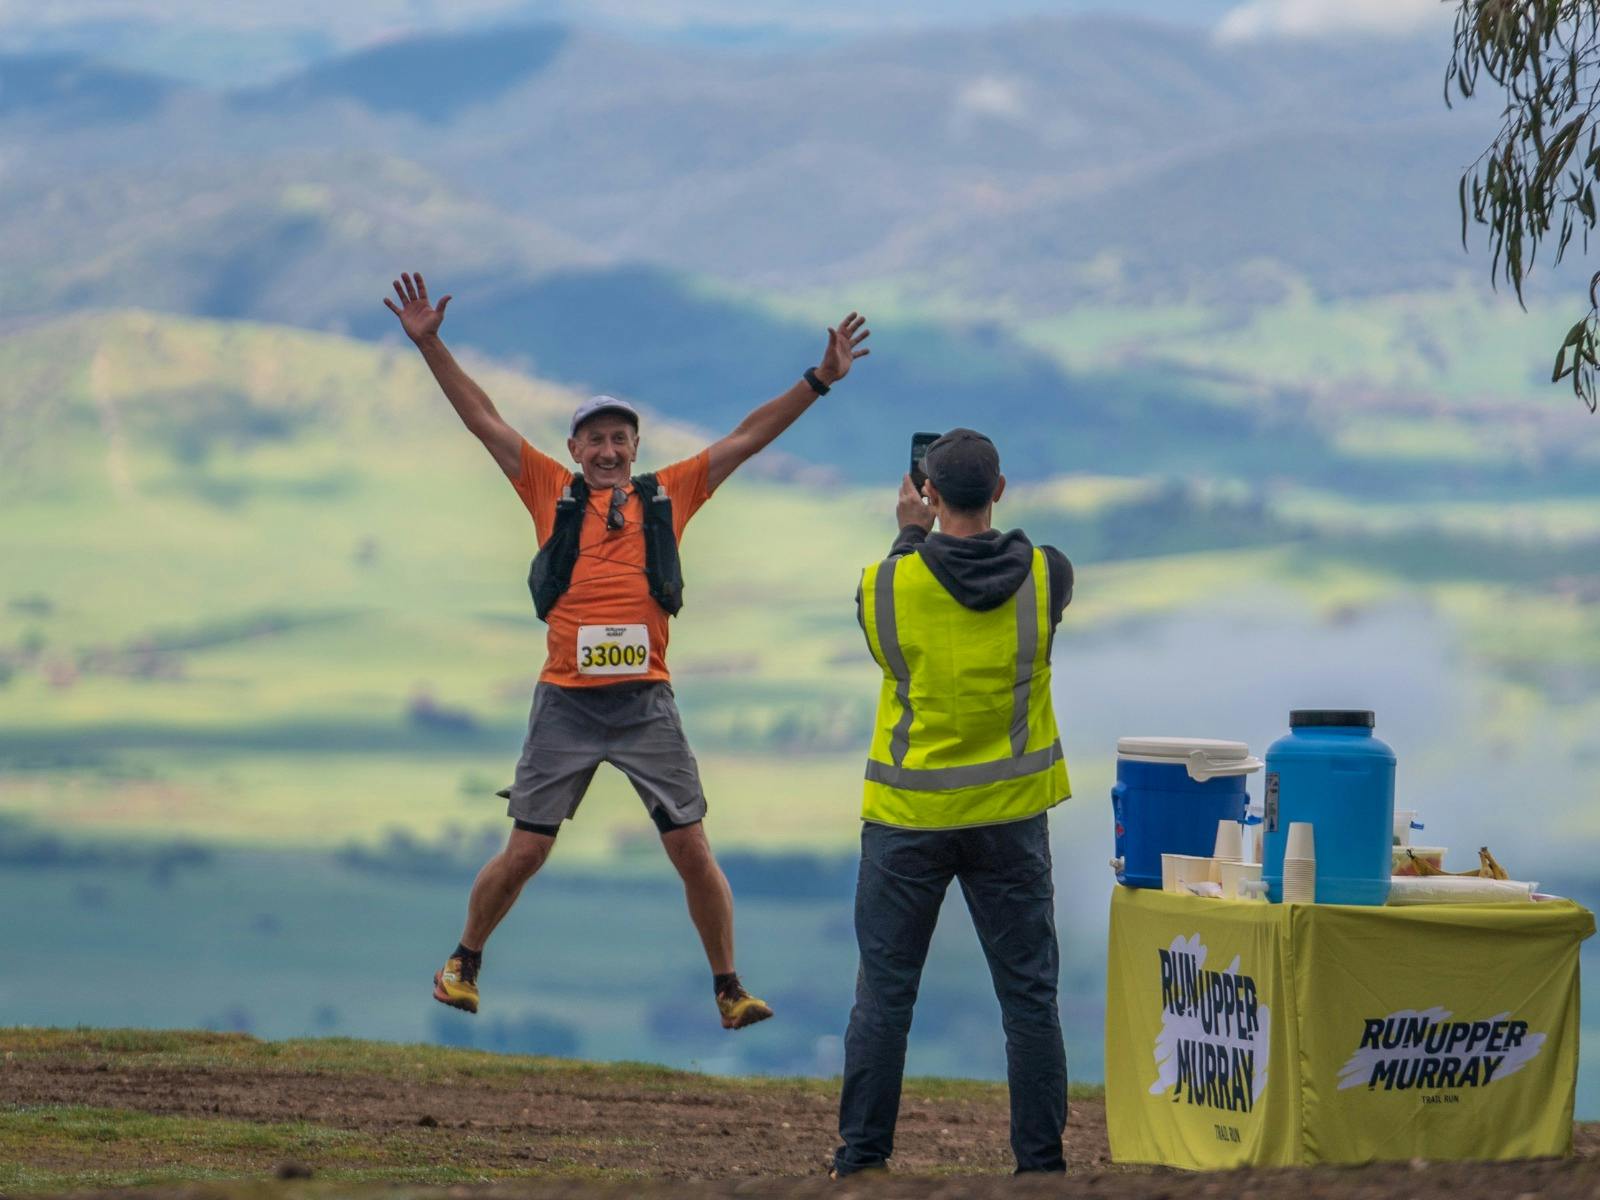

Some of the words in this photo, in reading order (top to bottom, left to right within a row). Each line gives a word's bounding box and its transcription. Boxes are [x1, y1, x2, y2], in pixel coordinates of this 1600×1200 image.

[581, 645, 646, 667] 33009
[1158, 948, 1198, 1018] RUN
[1197, 969, 1259, 1041] UPPER
[1360, 1017, 1429, 1050] RUN
[1425, 1020, 1528, 1054] UPPER
[1172, 1039, 1254, 1113] MURRAY
[1368, 1055, 1504, 1091] MURRAY
[1421, 1095, 1442, 1105] TRAIL
[1444, 1095, 1459, 1104] RUN
[1214, 1124, 1229, 1142] TRAIL
[1229, 1126, 1241, 1144] RUN
